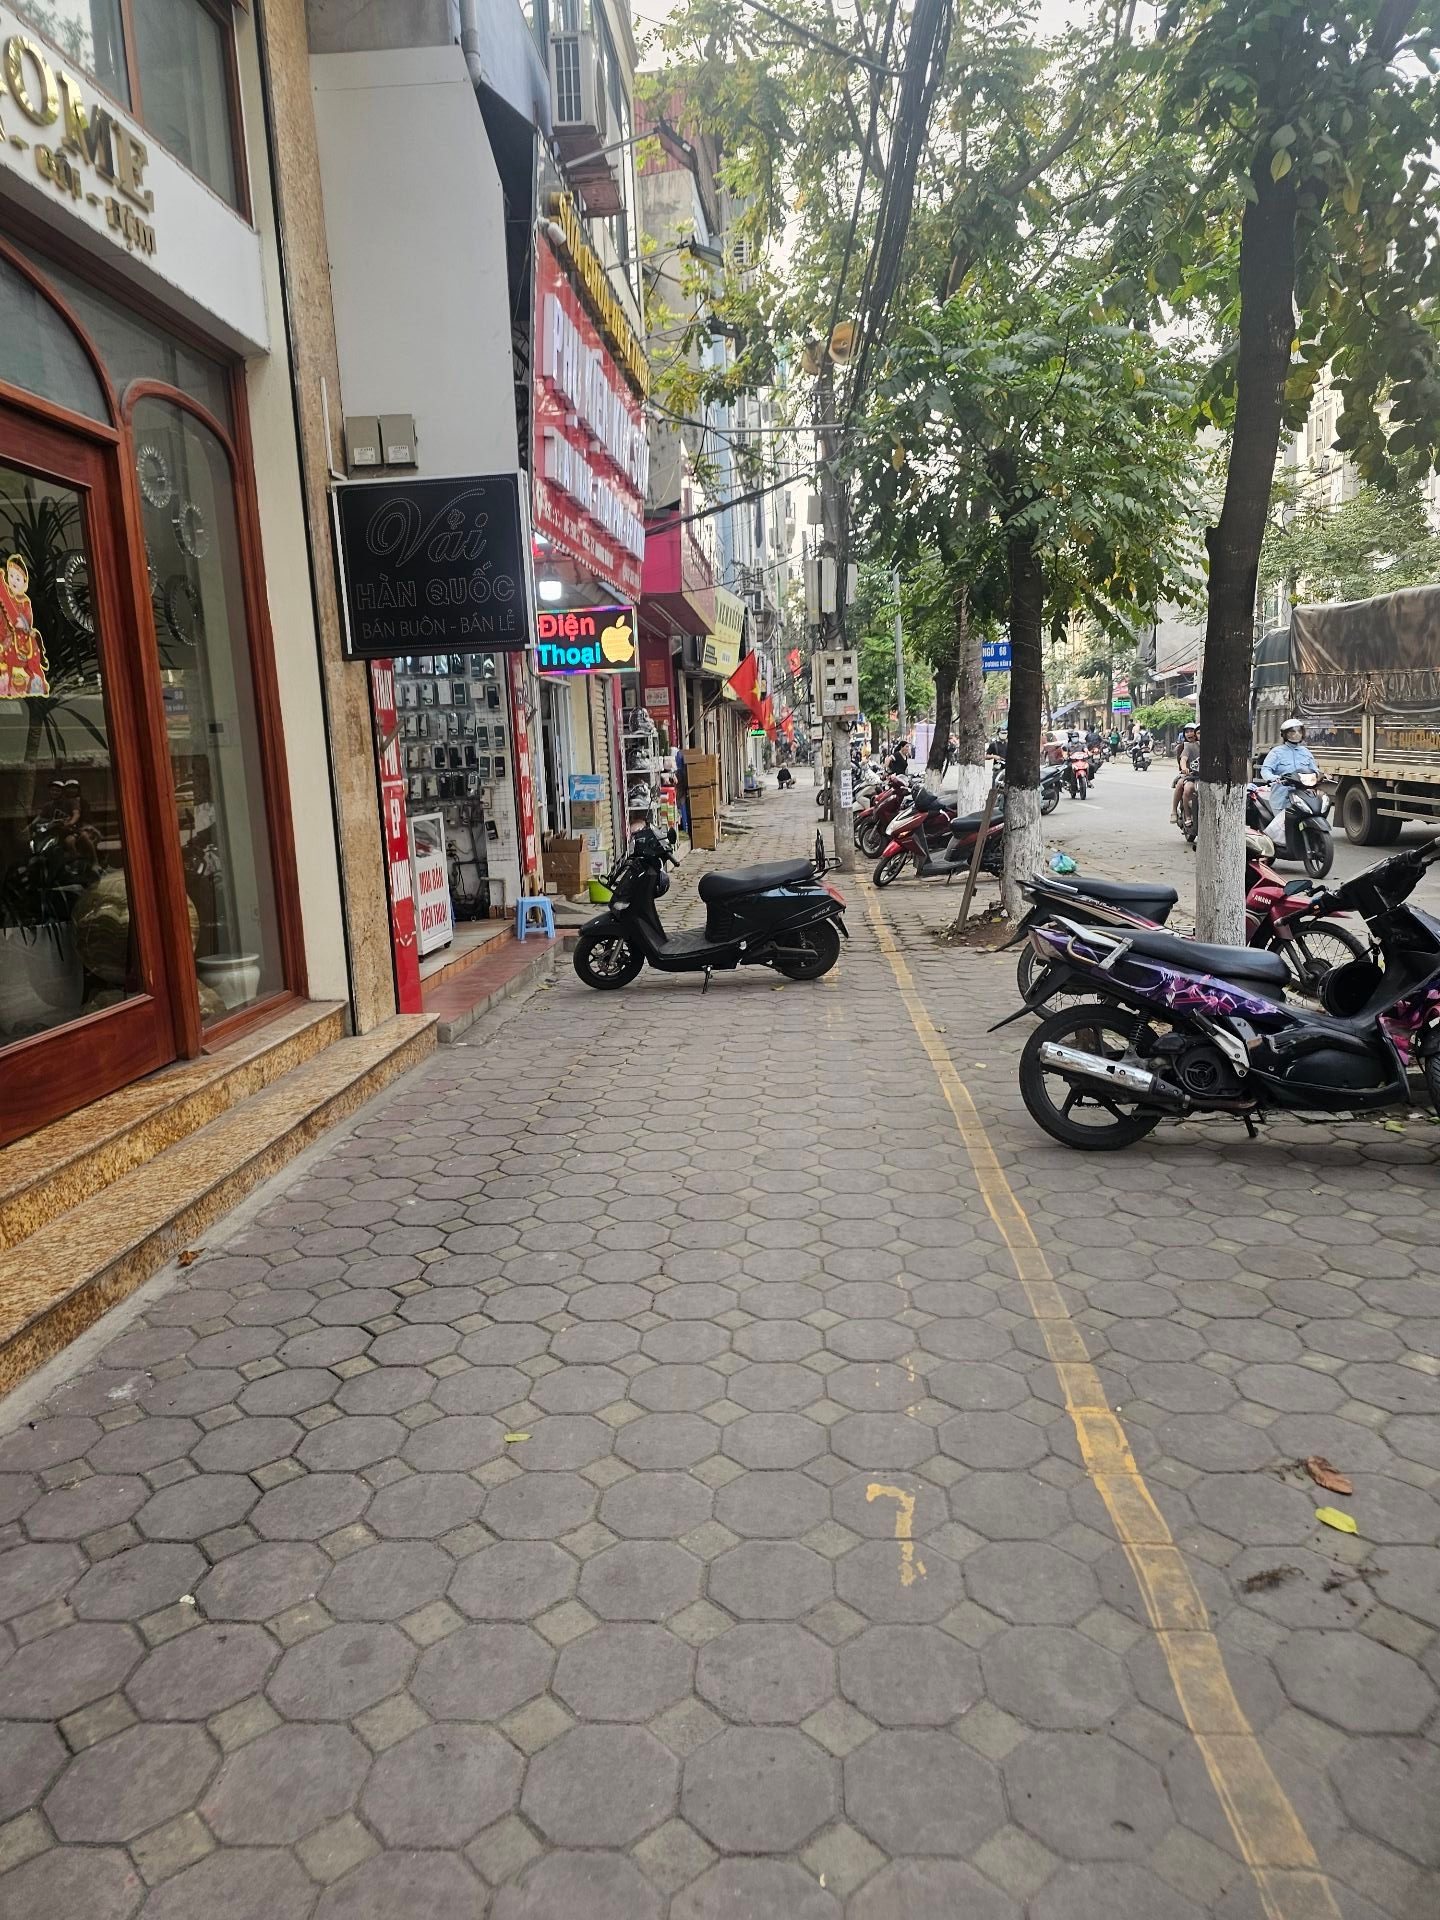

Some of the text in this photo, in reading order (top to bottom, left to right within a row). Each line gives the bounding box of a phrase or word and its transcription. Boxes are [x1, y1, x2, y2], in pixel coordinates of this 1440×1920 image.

[0, 36, 154, 213] OME
[355, 561, 515, 610] HÀN QUỐC
[363, 617, 395, 639] BÁN
[401, 616, 446, 637] BUÔN
[460, 612, 494, 634] BÁN
[500, 609, 516, 631] LẺ
[538, 613, 595, 641] Điện
[540, 643, 600, 668] Thoại
